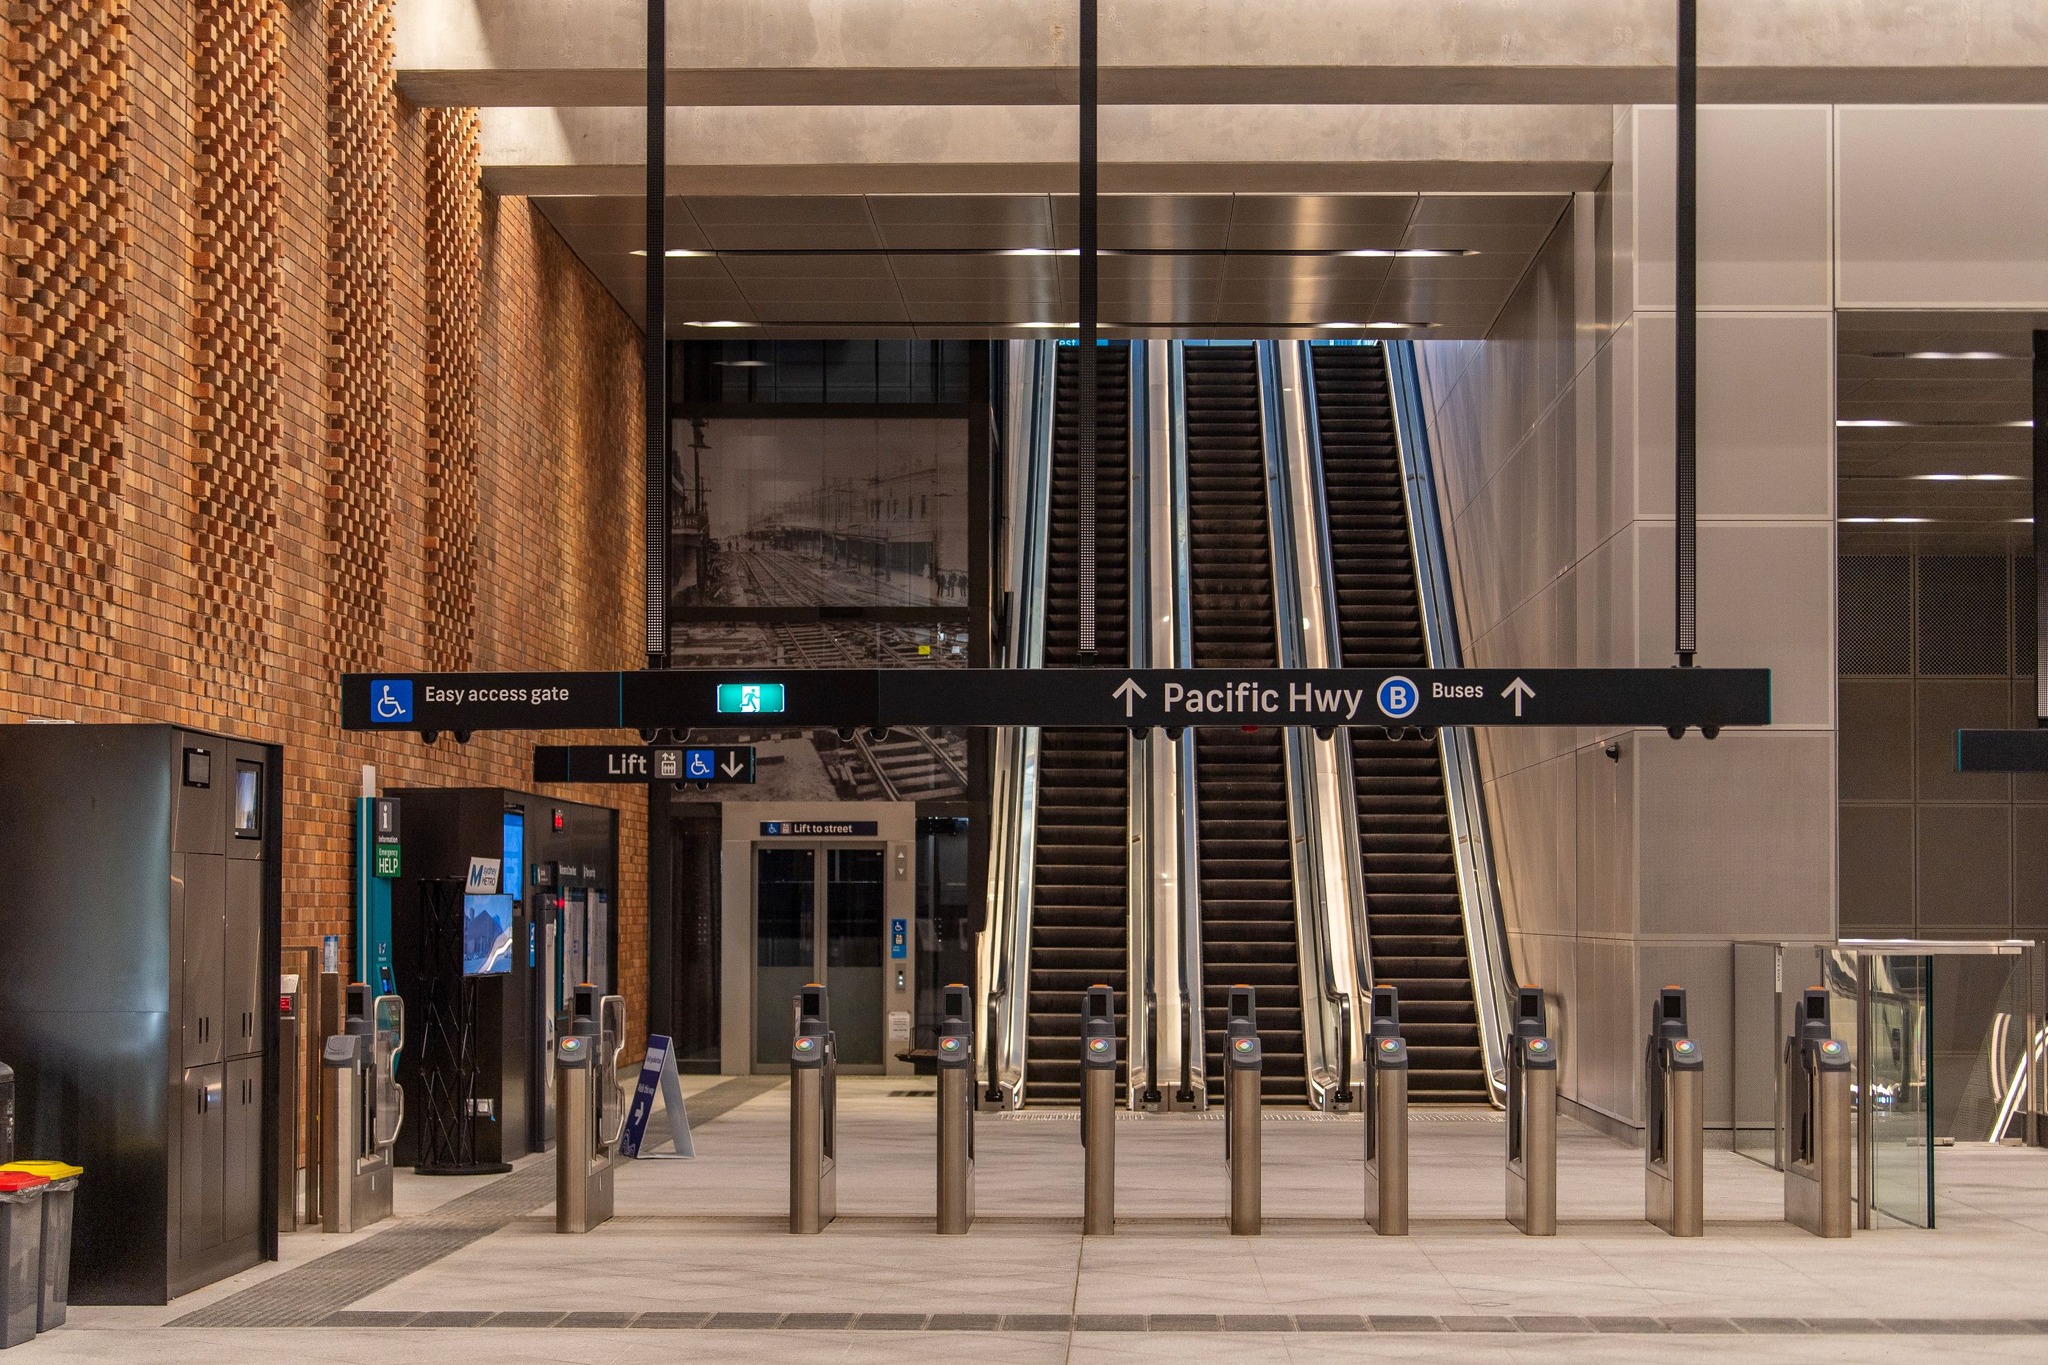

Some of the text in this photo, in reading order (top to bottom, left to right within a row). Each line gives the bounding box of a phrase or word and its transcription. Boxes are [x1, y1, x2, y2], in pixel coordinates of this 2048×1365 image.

[425, 686, 569, 705] Easy access gate
[1164, 682, 1484, 721] Pacific Hwy B Buses
[608, 753, 647, 774] Lift
[794, 824, 853, 833] Lift to street
[378, 848, 398, 857] Emergency
[378, 858, 399, 874] HELP
[482, 877, 495, 887] METRO
